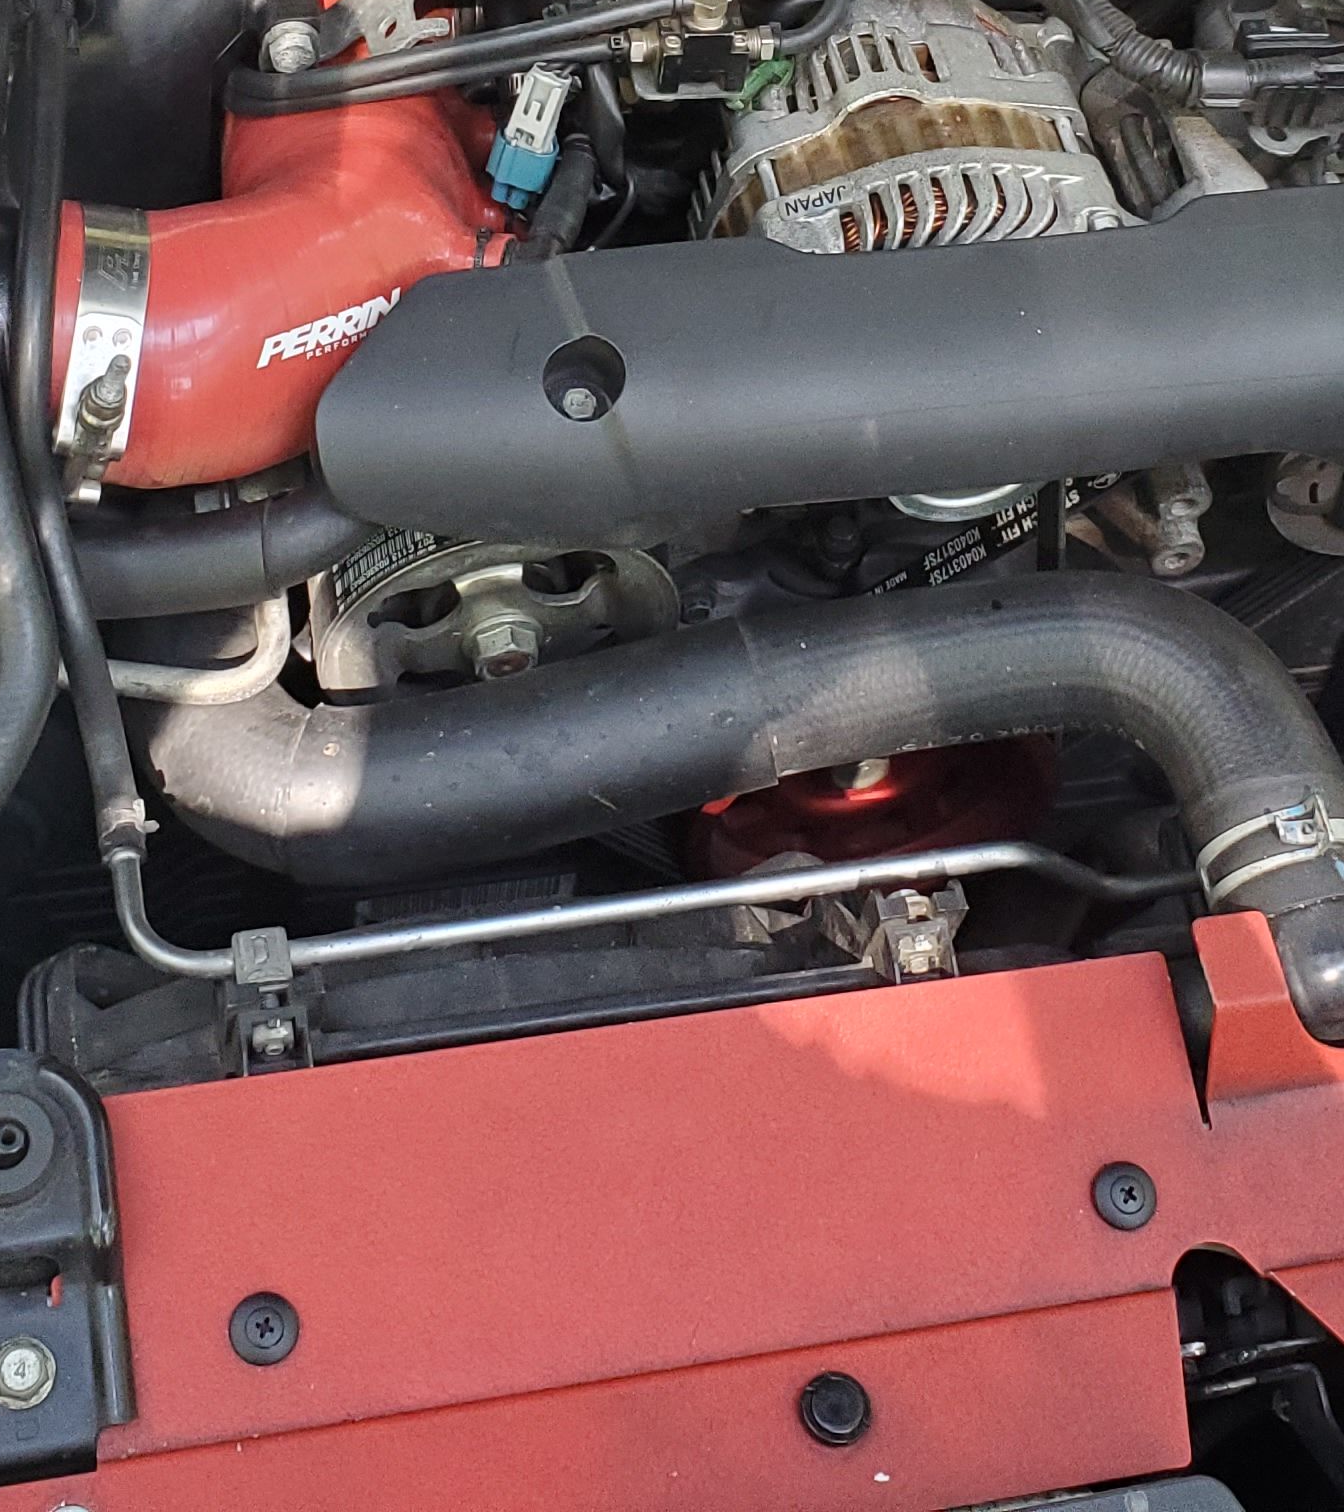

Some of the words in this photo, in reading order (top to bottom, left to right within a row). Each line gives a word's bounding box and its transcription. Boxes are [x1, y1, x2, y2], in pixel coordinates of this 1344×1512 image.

[784, 184, 846, 216] JAPAN
[256, 287, 401, 369] PERRIN
[305, 332, 366, 360] PERFORM
[922, 526, 981, 571] K040317SF
[928, 543, 987, 587] K040317SF
[886, 571, 908, 587] MADE
